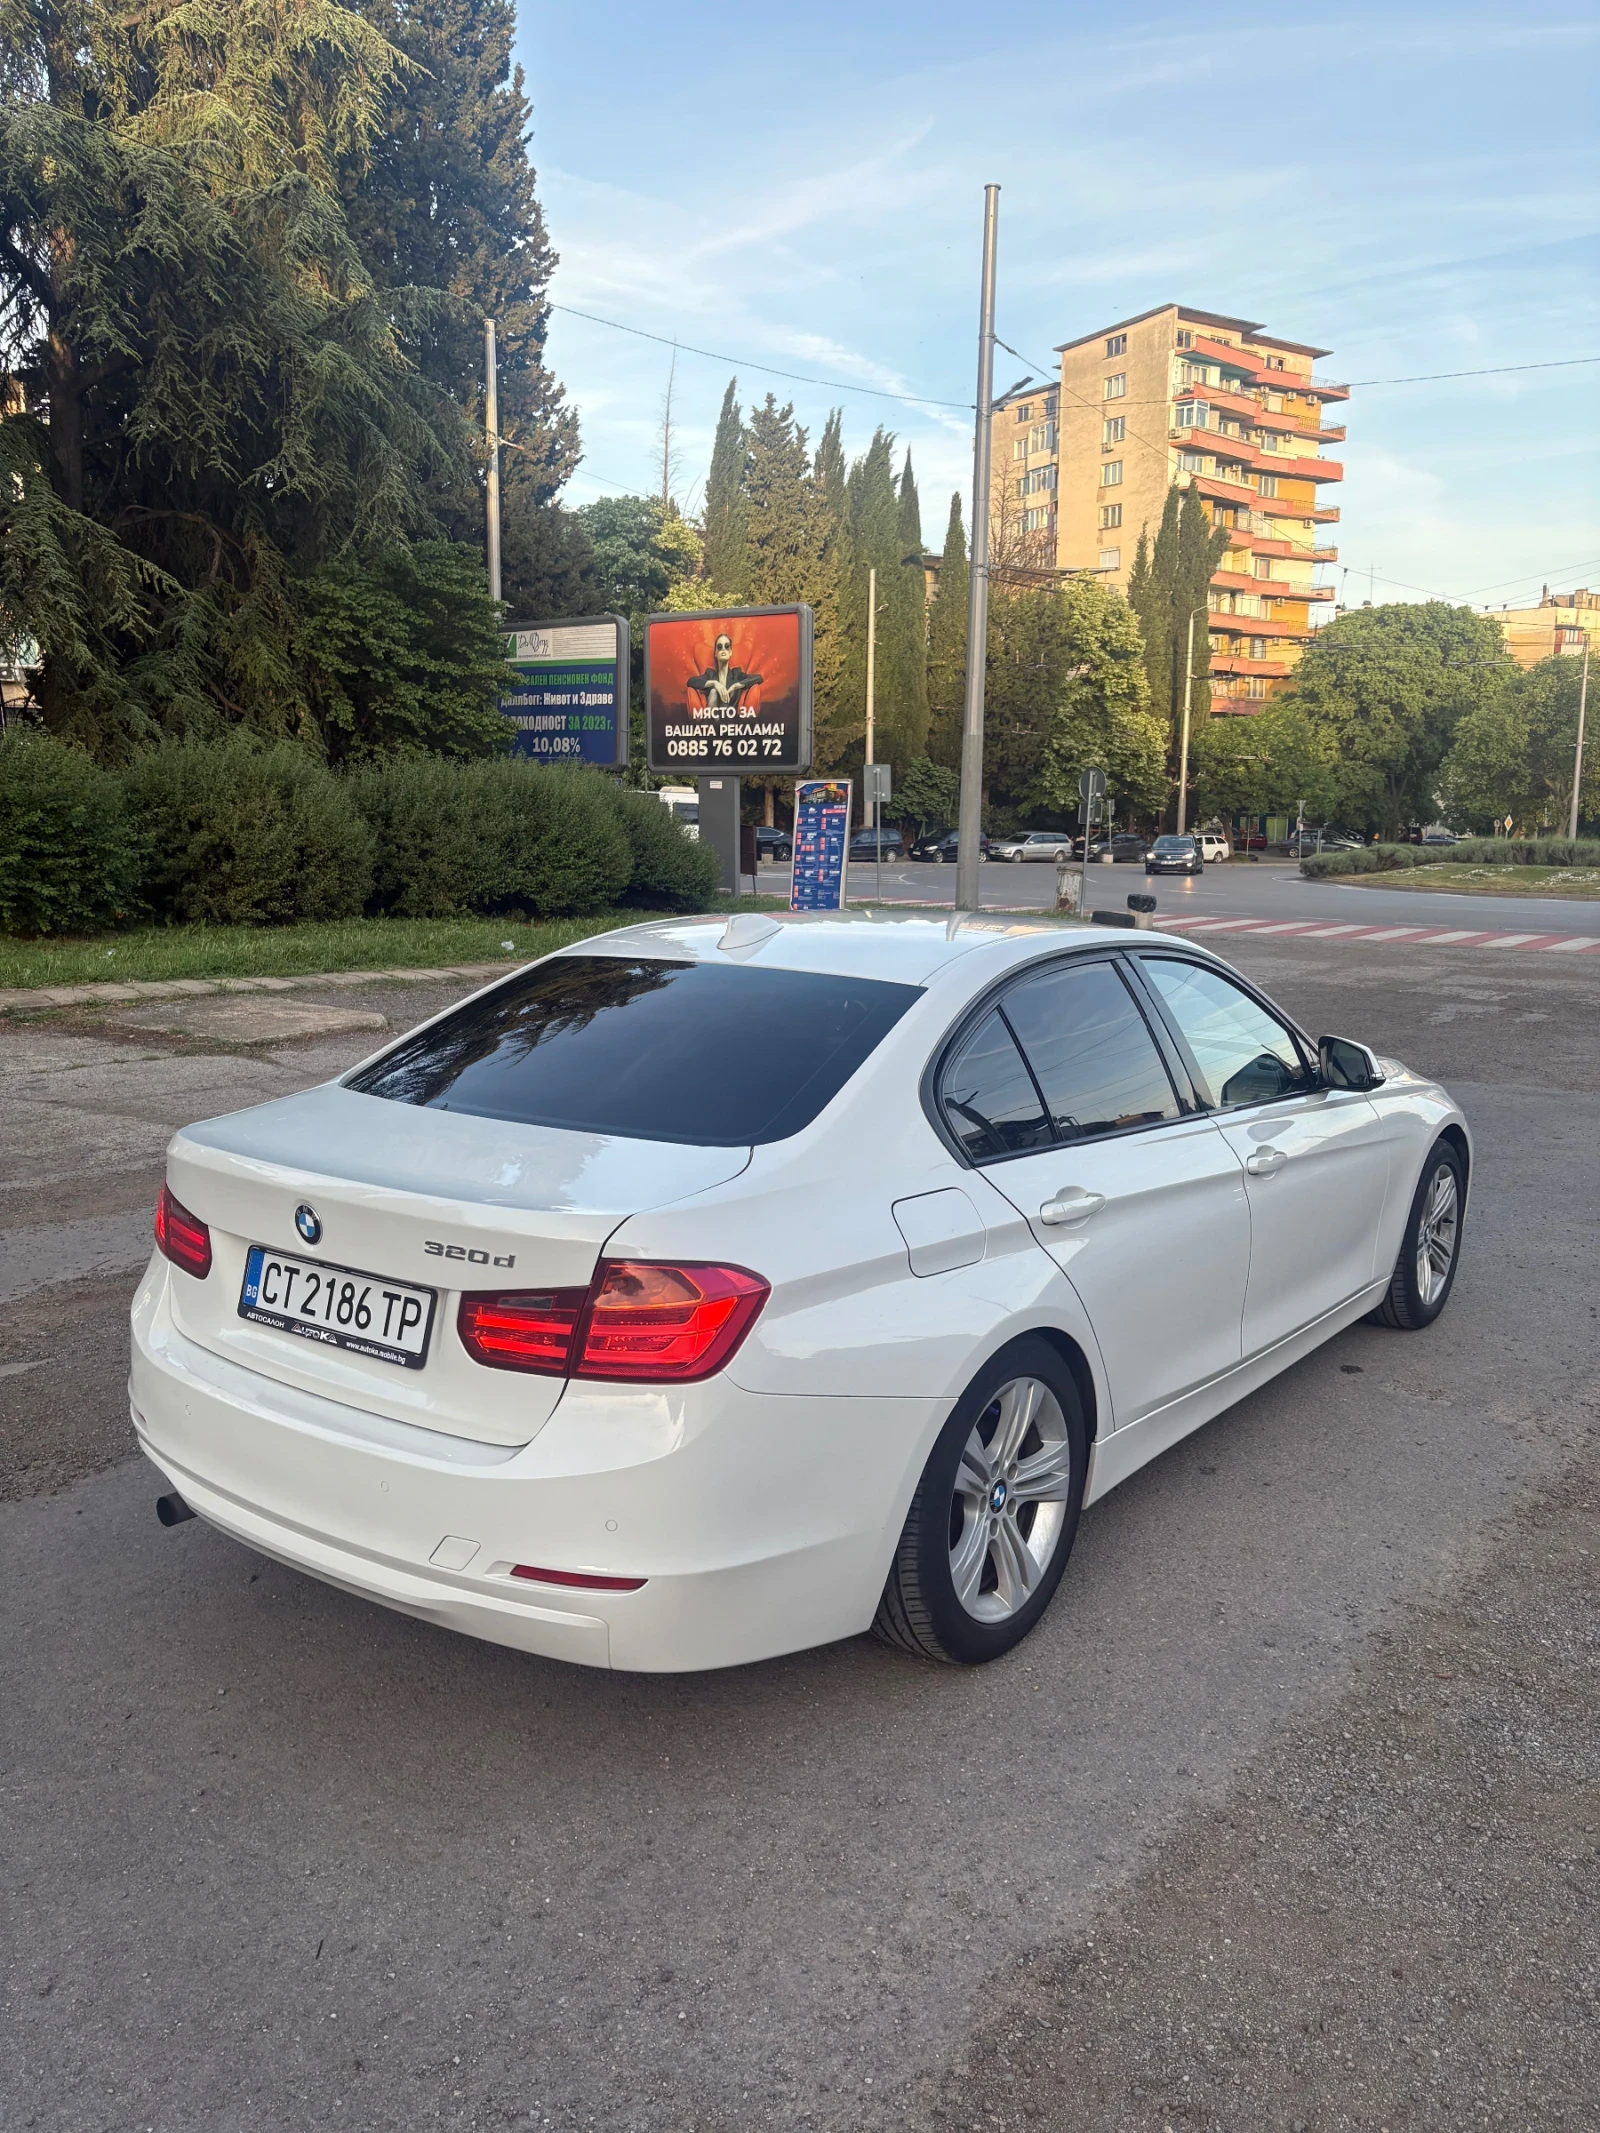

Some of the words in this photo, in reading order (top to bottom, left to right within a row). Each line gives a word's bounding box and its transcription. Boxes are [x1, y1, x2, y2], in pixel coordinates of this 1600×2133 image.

[549, 673, 590, 685] ПЕНСИОНЕН
[591, 672, 614, 685] ФОНД
[543, 692, 571, 705] Живот
[572, 694, 578, 705] и
[580, 691, 613, 706] Здраве
[693, 706, 736, 719] МЯСТО
[739, 706, 756, 718] ЗА
[568, 715, 580, 730] ЗА
[665, 724, 716, 737] ВАШАТА
[720, 723, 785, 736] РЕКЛАМА!
[532, 737, 580, 755] 10,08%
[667, 740, 708, 756] 0885
[712, 740, 732, 756] 76
[737, 740, 757, 756] 02
[762, 739, 782, 756] 72
[246, 1284, 258, 1298] BG
[262, 1262, 300, 1309] CT
[300, 1273, 372, 1330] 2186
[382, 1290, 422, 1341] TP
[247, 1311, 285, 1328] АВТОСАЛОН
[346, 1341, 406, 1364] www.autoka.mobile.bg
